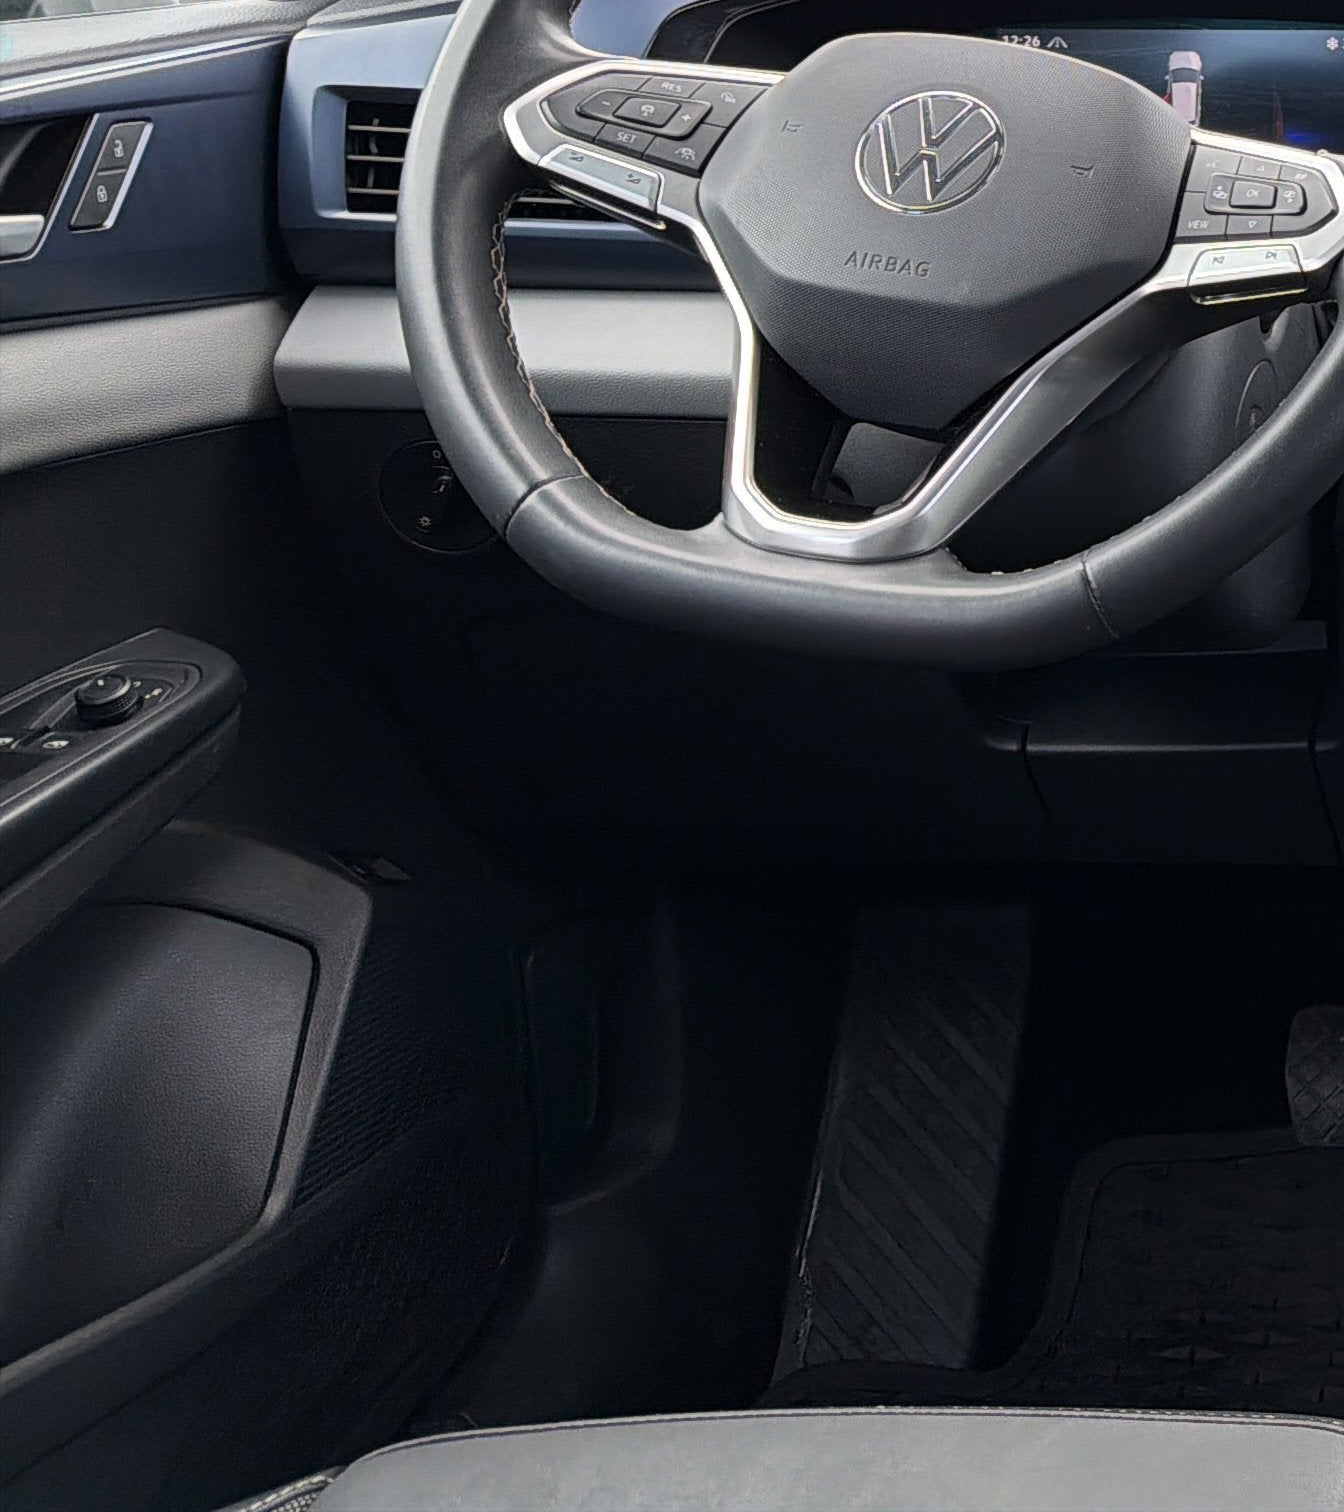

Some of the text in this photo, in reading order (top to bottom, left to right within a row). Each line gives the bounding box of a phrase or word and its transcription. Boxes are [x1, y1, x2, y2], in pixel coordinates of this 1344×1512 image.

[660, 81, 682, 93] RES
[615, 131, 638, 144] SET
[1246, 188, 1261, 198] OK
[1187, 219, 1210, 230] VIEW
[843, 250, 931, 277] AIRBAG
